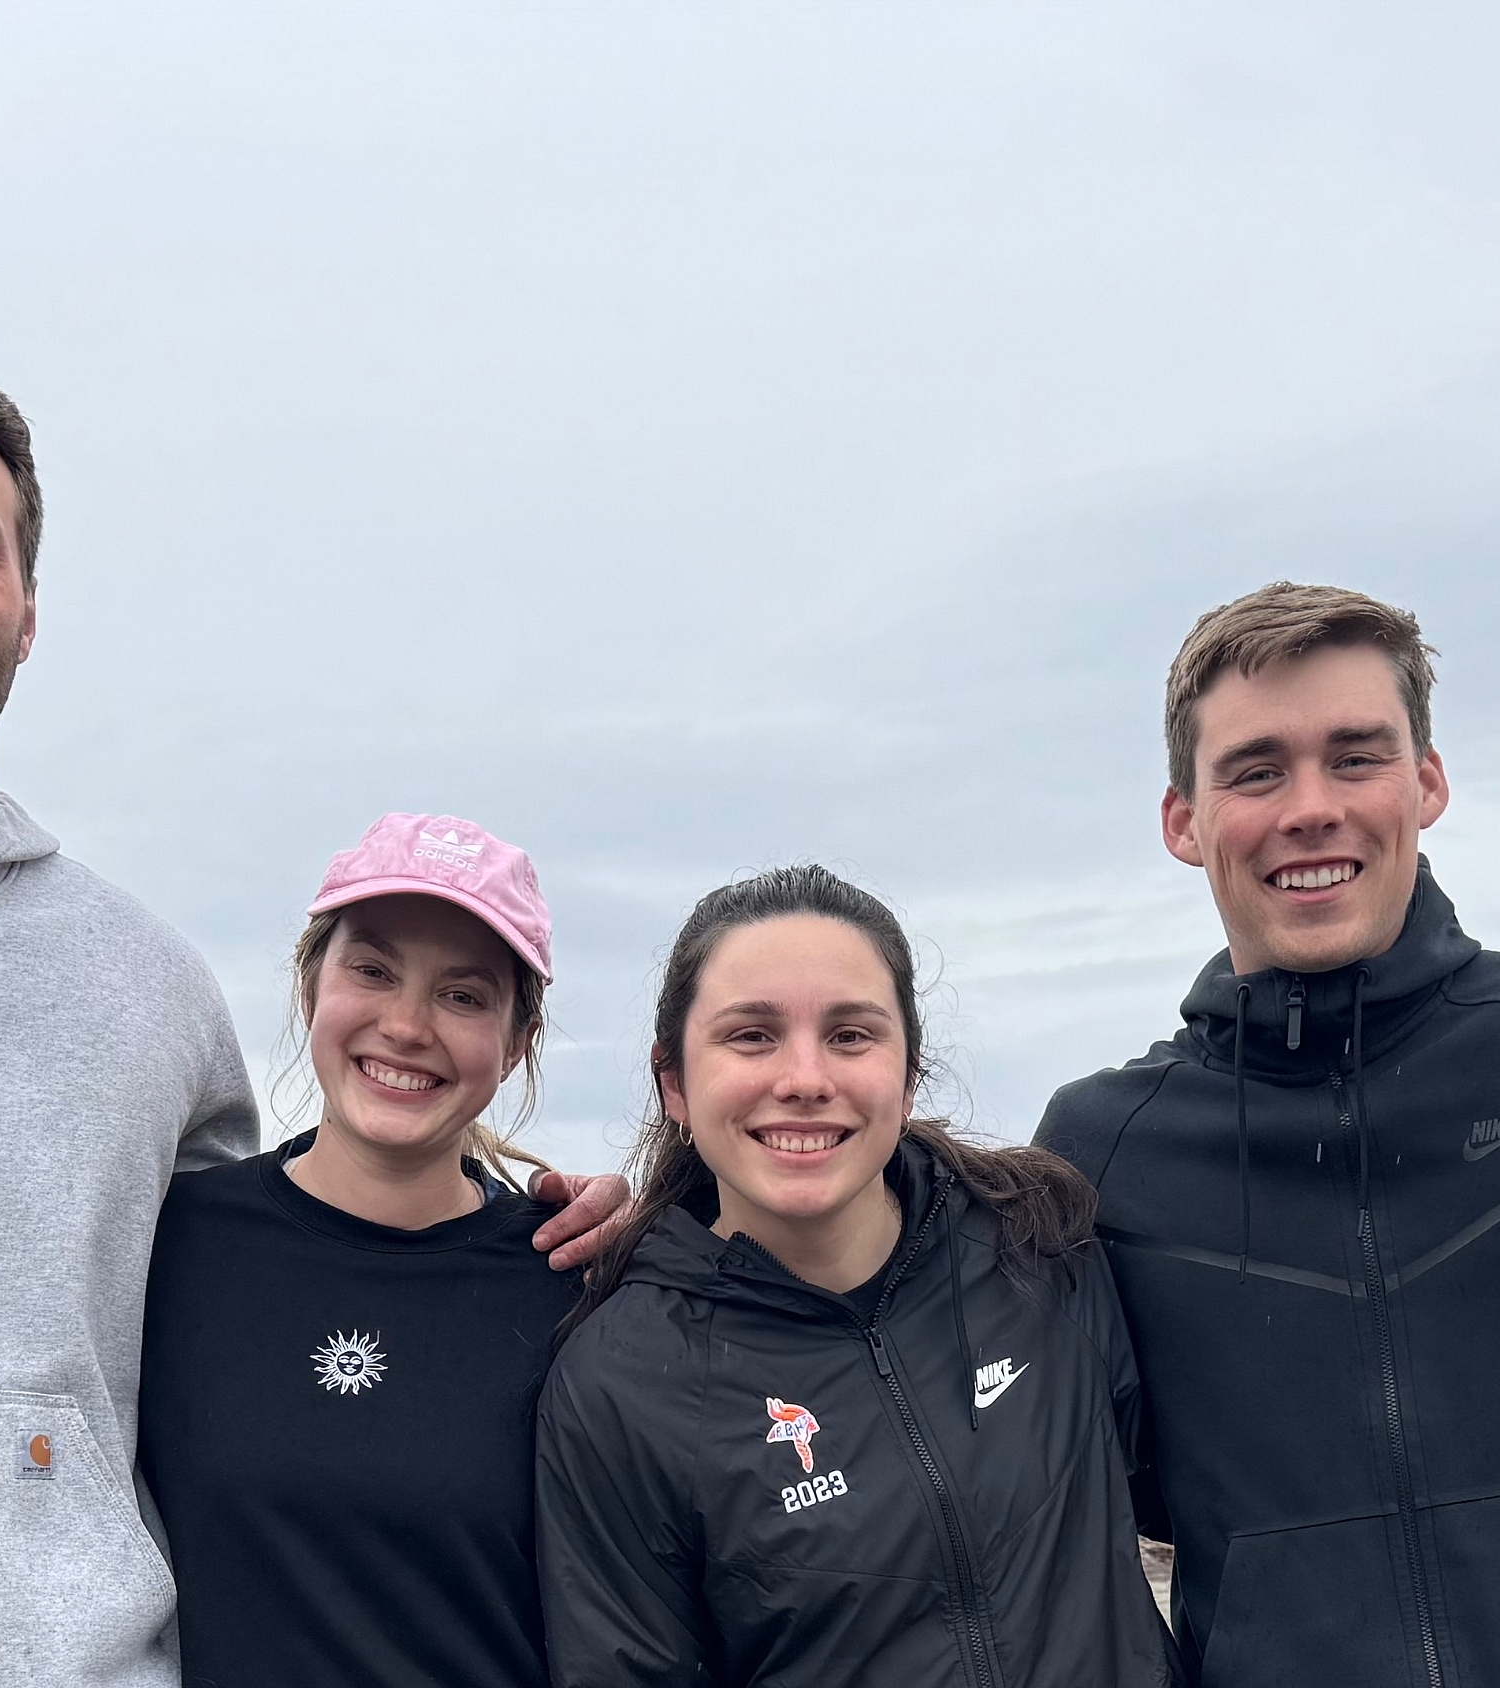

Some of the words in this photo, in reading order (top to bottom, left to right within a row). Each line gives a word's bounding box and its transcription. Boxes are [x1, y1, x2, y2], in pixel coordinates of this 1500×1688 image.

[412, 848, 478, 873] adidas
[975, 1357, 1014, 1391] NIKE
[780, 1469, 850, 1514] 2023
